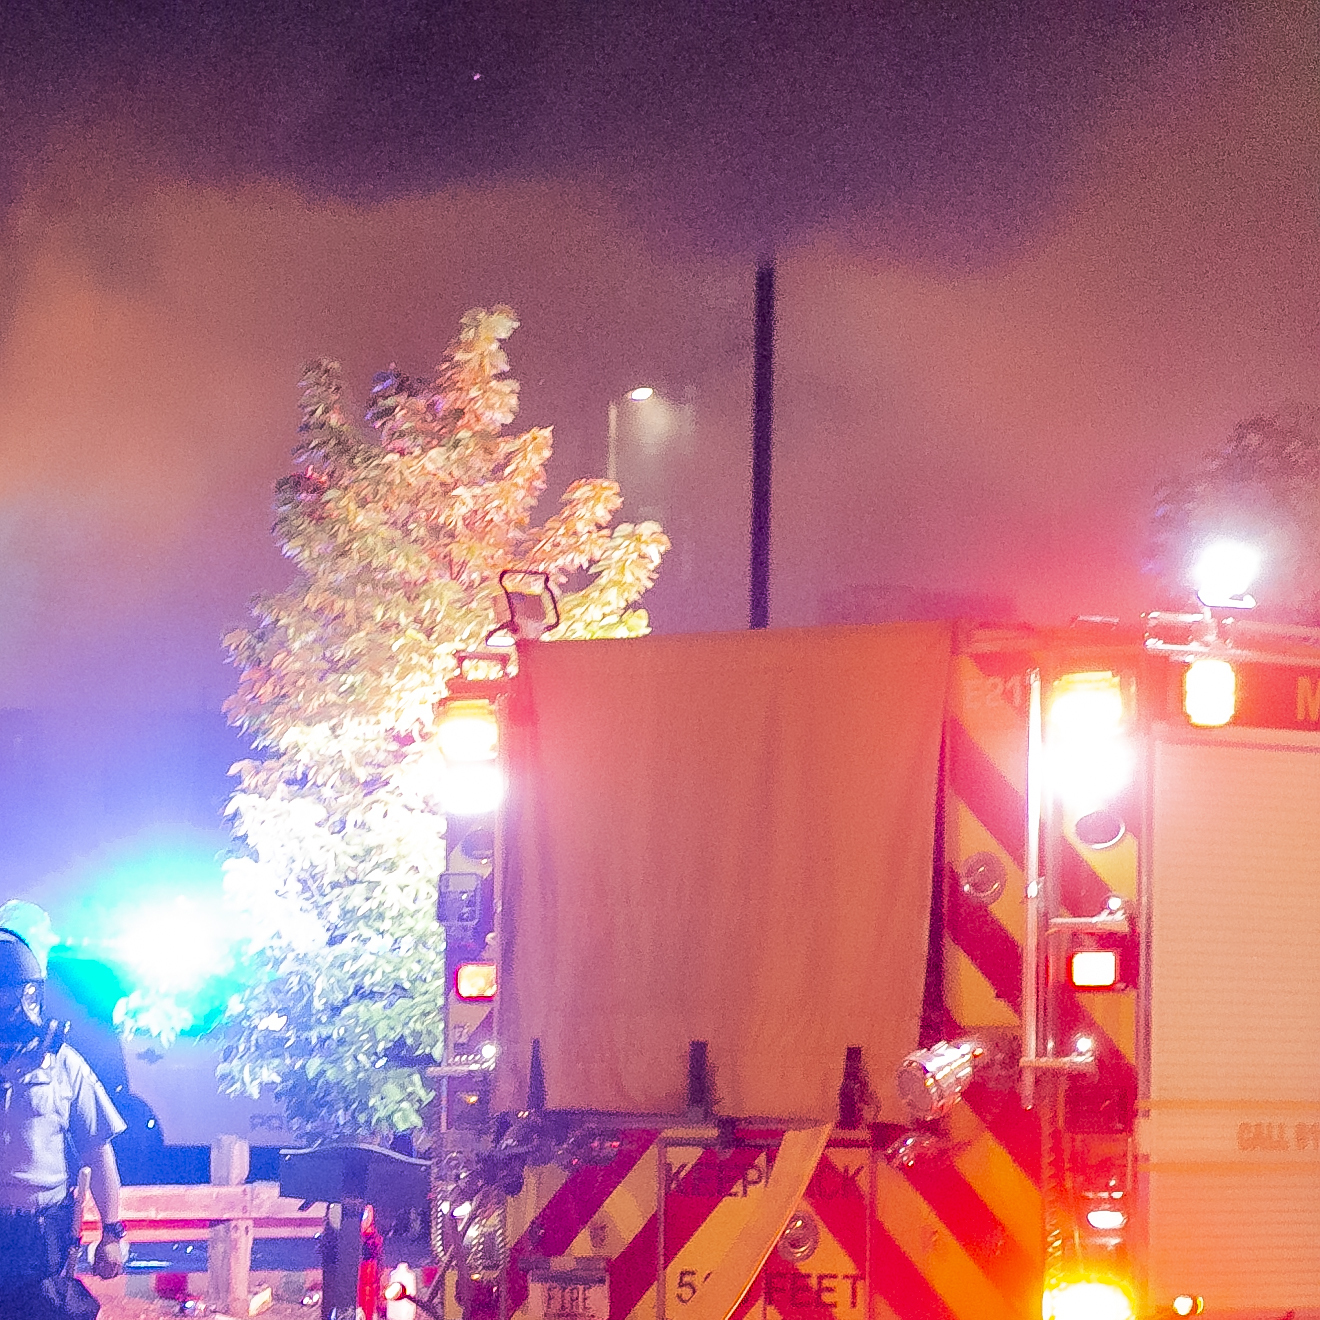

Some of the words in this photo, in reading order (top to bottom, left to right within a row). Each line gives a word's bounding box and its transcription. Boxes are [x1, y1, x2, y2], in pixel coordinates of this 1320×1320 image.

[963, 673, 1023, 710] E21
[1238, 1121, 1289, 1151] CALL
[663, 1162, 764, 1197] KEEP
[547, 1286, 592, 1311] FIRE
[764, 1272, 865, 1309] FEET
